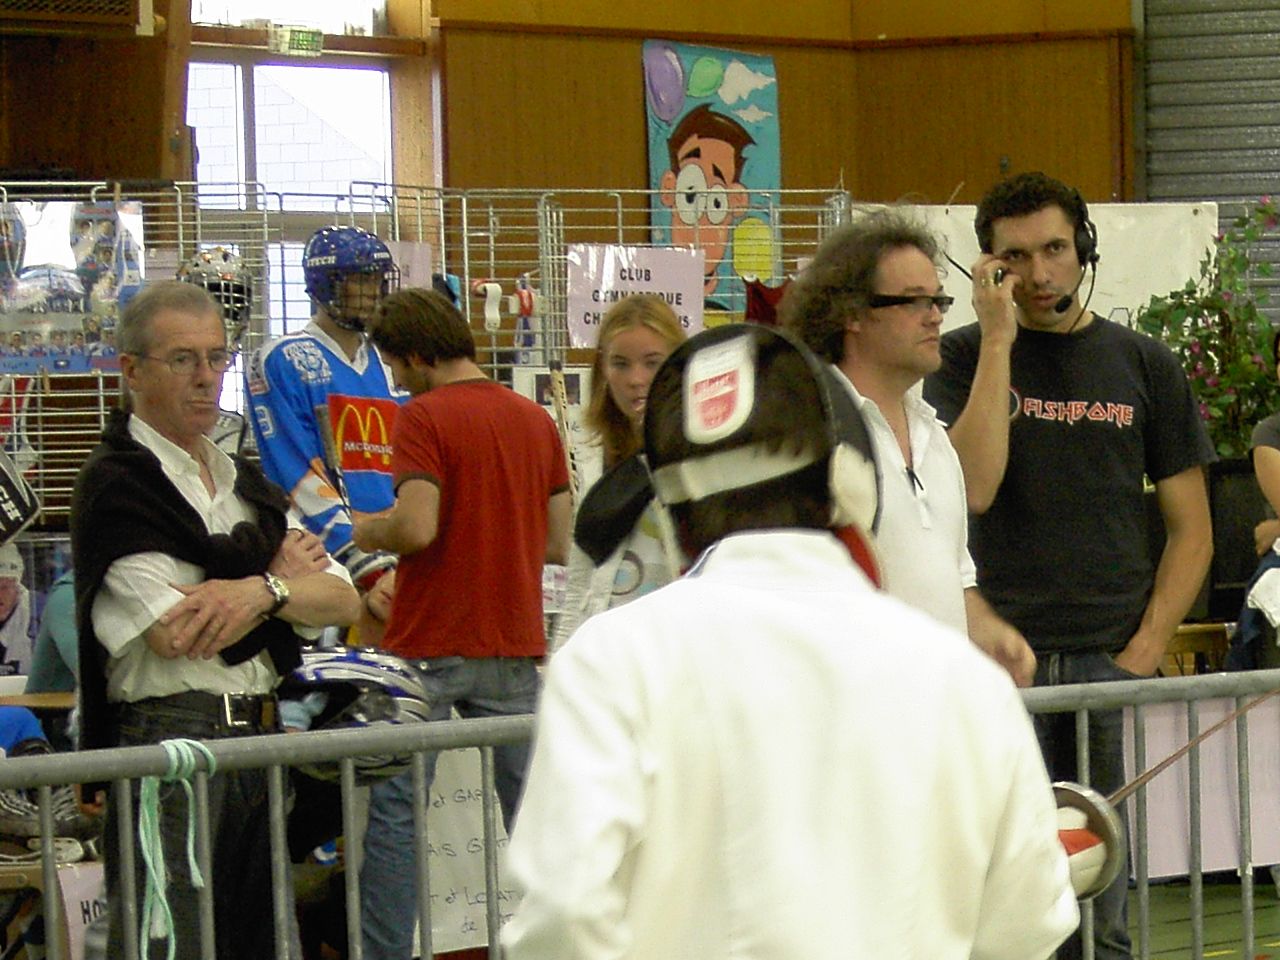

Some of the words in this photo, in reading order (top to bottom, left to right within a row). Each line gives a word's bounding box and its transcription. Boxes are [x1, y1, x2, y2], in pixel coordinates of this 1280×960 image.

[619, 268, 651, 282] CLUB
[1023, 397, 1134, 429] FISHBONE
[80, 899, 103, 925] HO
